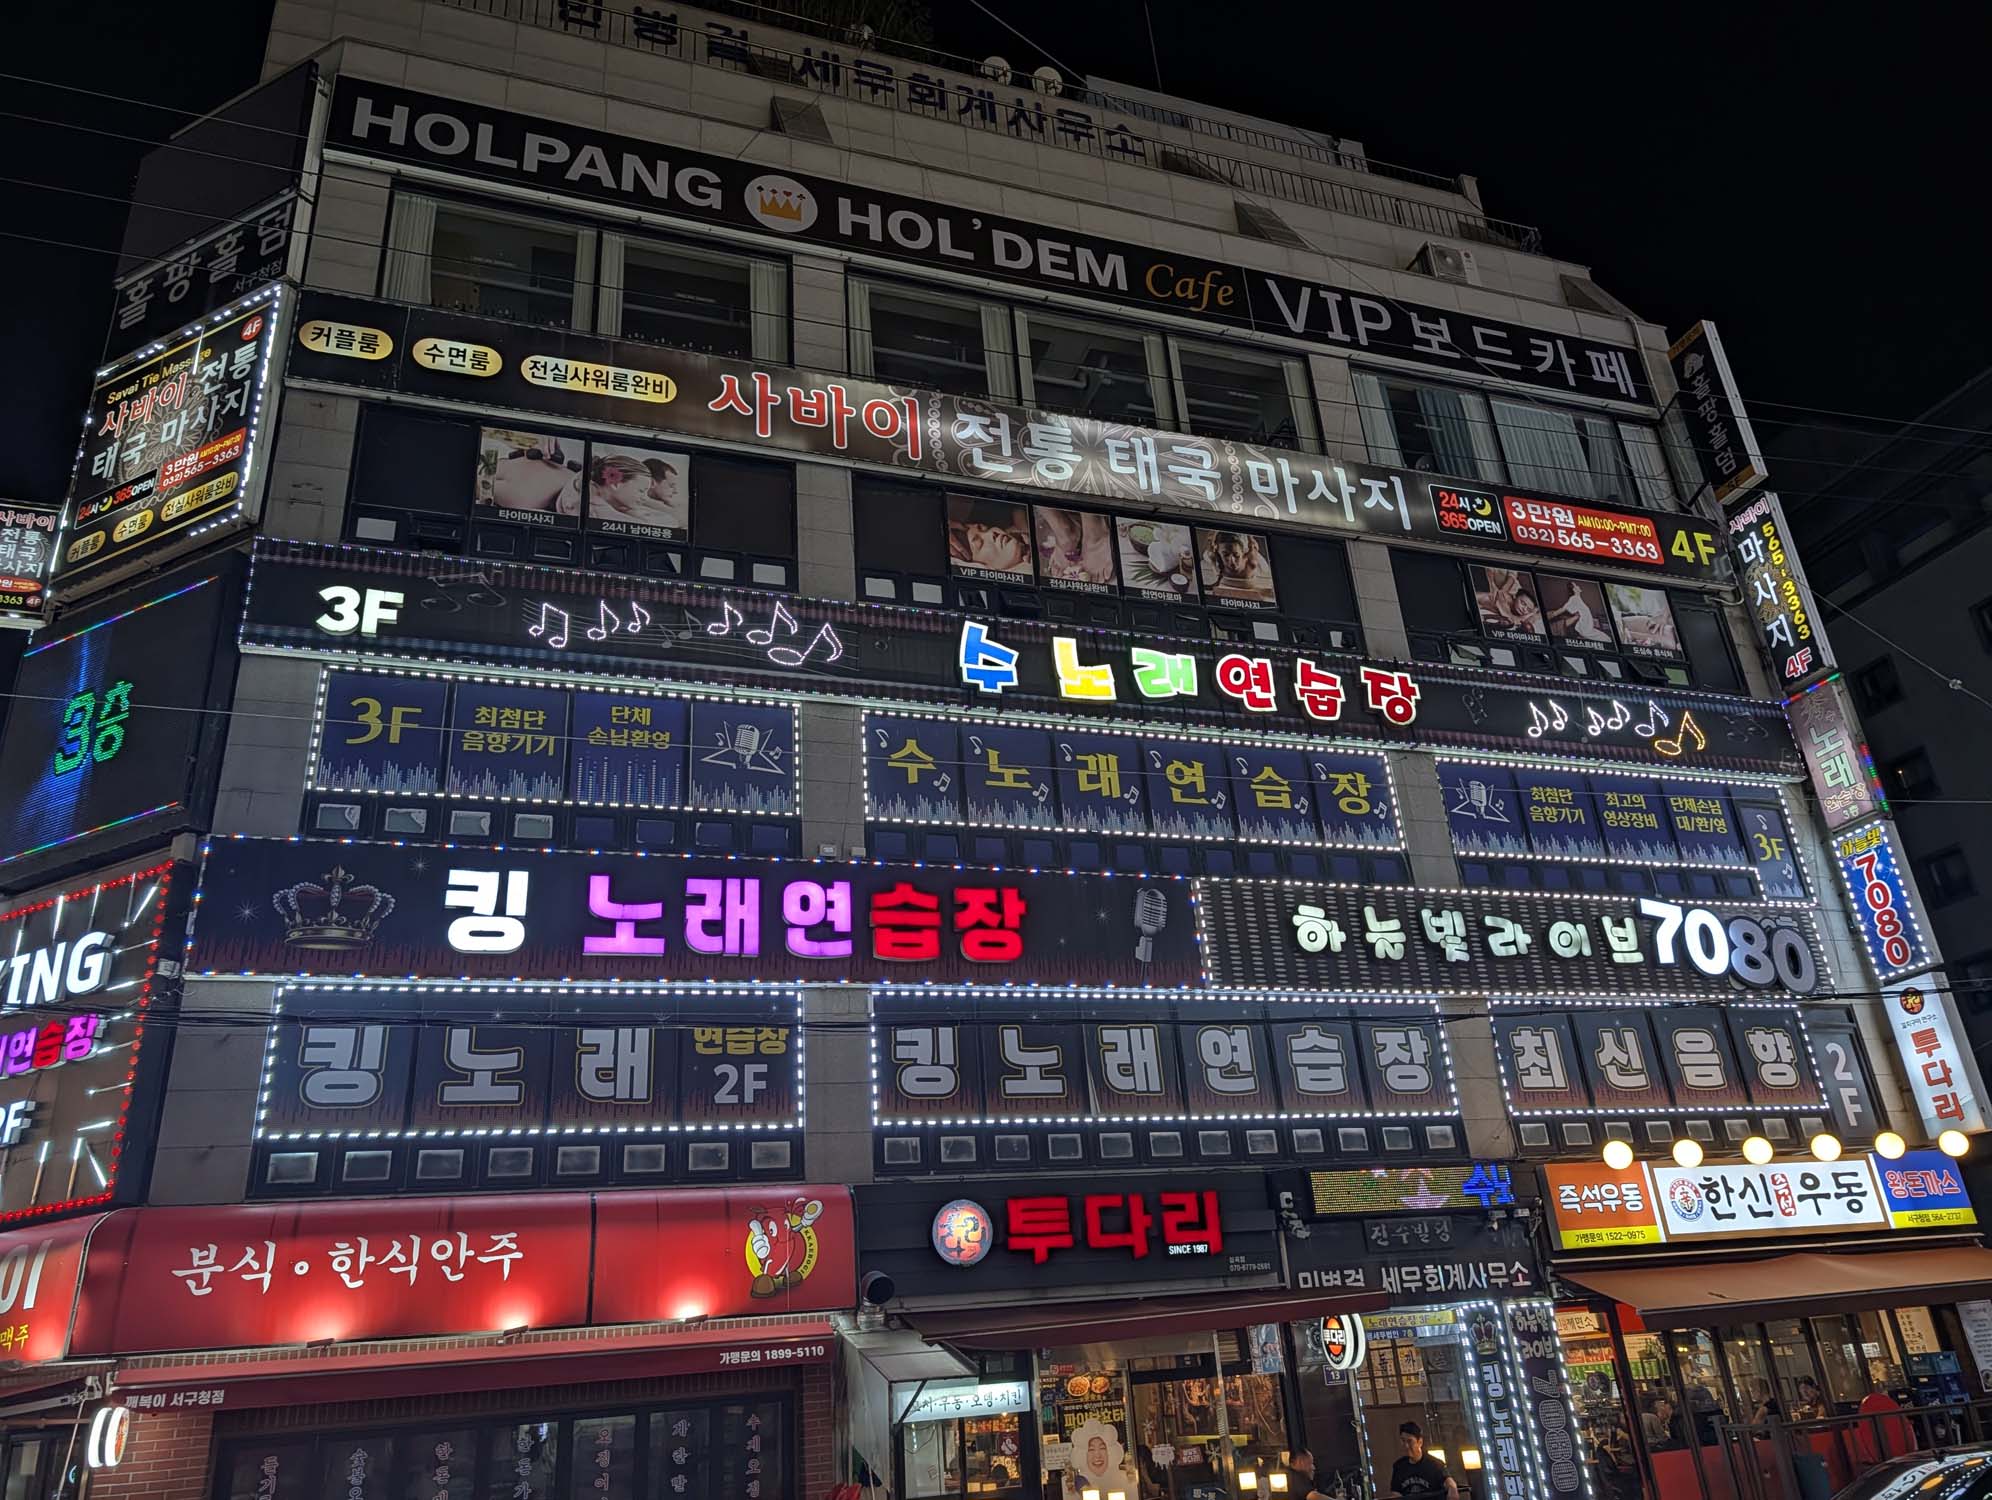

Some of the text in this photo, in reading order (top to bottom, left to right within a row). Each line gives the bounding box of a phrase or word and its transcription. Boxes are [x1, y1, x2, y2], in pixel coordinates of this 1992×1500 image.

[798, 48, 1145, 158] 세무회계사무소
[351, 97, 1235, 311] HOLPANG HOL'DEM Cafe
[242, 318, 262, 339] 4F
[309, 325, 380, 356] 커플룸
[1267, 279, 1638, 398] VIP 보드카페
[424, 343, 490, 372] 수면룸
[98, 340, 258, 438] 사바이 전통
[107, 380, 139, 405] Savai
[142, 373, 160, 391] Tie
[529, 358, 670, 399] 전실샤워룸완비
[92, 379, 251, 480] 태국 마사지
[163, 445, 240, 488] 032)565-3363
[165, 450, 199, 476] 3만원
[708, 372, 1413, 531] 사바이 전통 태국 마사지
[77, 477, 155, 521] 24시 365OPEN
[1439, 489, 1471, 511] 24시
[1511, 501, 1576, 529] 3만원
[498, 509, 555, 525] 타이마사지
[602, 521, 627, 533] 24시
[1439, 510, 1502, 536] 365OPEN
[1729, 496, 1771, 535] 사바이
[1, 528, 41, 545] 전통
[70, 538, 101, 561] 커플룸
[118, 514, 149, 538] 수면룸
[1517, 525, 1659, 562] 032)565-3363
[1671, 529, 1717, 566] 4F
[0, 560, 44, 578] 사지
[960, 567, 1025, 583] VIP 타이마사지
[1737, 531, 1794, 649] 마사지
[315, 585, 405, 637] 3F
[1491, 629, 1505, 639] VIP
[959, 620, 1421, 727] 수노래연습장
[1785, 646, 1813, 679] 4F
[53, 681, 135, 776] 3층
[346, 697, 424, 745] 3F
[474, 706, 547, 731] 최첨단
[610, 705, 652, 727] 단체
[461, 729, 555, 758] 음향기기
[588, 727, 672, 752] 손님환영
[1809, 726, 1857, 789] 노래
[887, 738, 1371, 816] 수노래연습장
[1531, 785, 1574, 806] 최첨단
[1604, 791, 1646, 811] 최고의
[1670, 796, 1724, 816] 단체손님
[1824, 782, 1866, 814] 연습장
[1529, 805, 1586, 826] 음향기기
[1603, 810, 1658, 831] 영상장비
[1676, 815, 1729, 835] 대/환/영
[1842, 804, 1860, 820] 3층
[1753, 833, 1785, 862] 3F
[1840, 826, 1881, 858] 하늘빛
[443, 869, 1027, 962] 킹 노래연습장
[1854, 850, 1911, 968] 7080
[1293, 898, 1818, 994] 하늘빛라이브 7080
[694, 1025, 789, 1055] 연습장
[891, 1024, 1432, 1099] 킹노래연습장
[1509, 1026, 1799, 1092] 최신음향
[1911, 1027, 1965, 1123] 투다리
[713, 1064, 768, 1105] 2F
[1825, 1042, 1863, 1127] 2F
[1557, 1182, 1644, 1215] 즉석우동
[1699, 1172, 1774, 1221] 한신
[1797, 1170, 1868, 1216] 우동
[1885, 1169, 1962, 1199] 왕돈까스
[1006, 1191, 1224, 1264] 투다리
[1370, 1219, 1451, 1246] 진수빌딩
[1575, 1230, 1646, 1244] 가맹문의 1522-0975
[172, 1231, 524, 1296] 분식 한식안주
[1168, 1244, 1209, 1255] SINCE 1987
[1381, 1260, 1532, 1295] 세무회계사무소
[0, 1324, 29, 1352] 맥주
[1323, 1328, 1346, 1345] 투다리
[719, 1345, 825, 1364] 가맹문의 1899-5110
[170, 1389, 225, 1406] 서구청점
[1532, 1368, 1580, 1493] 7080
